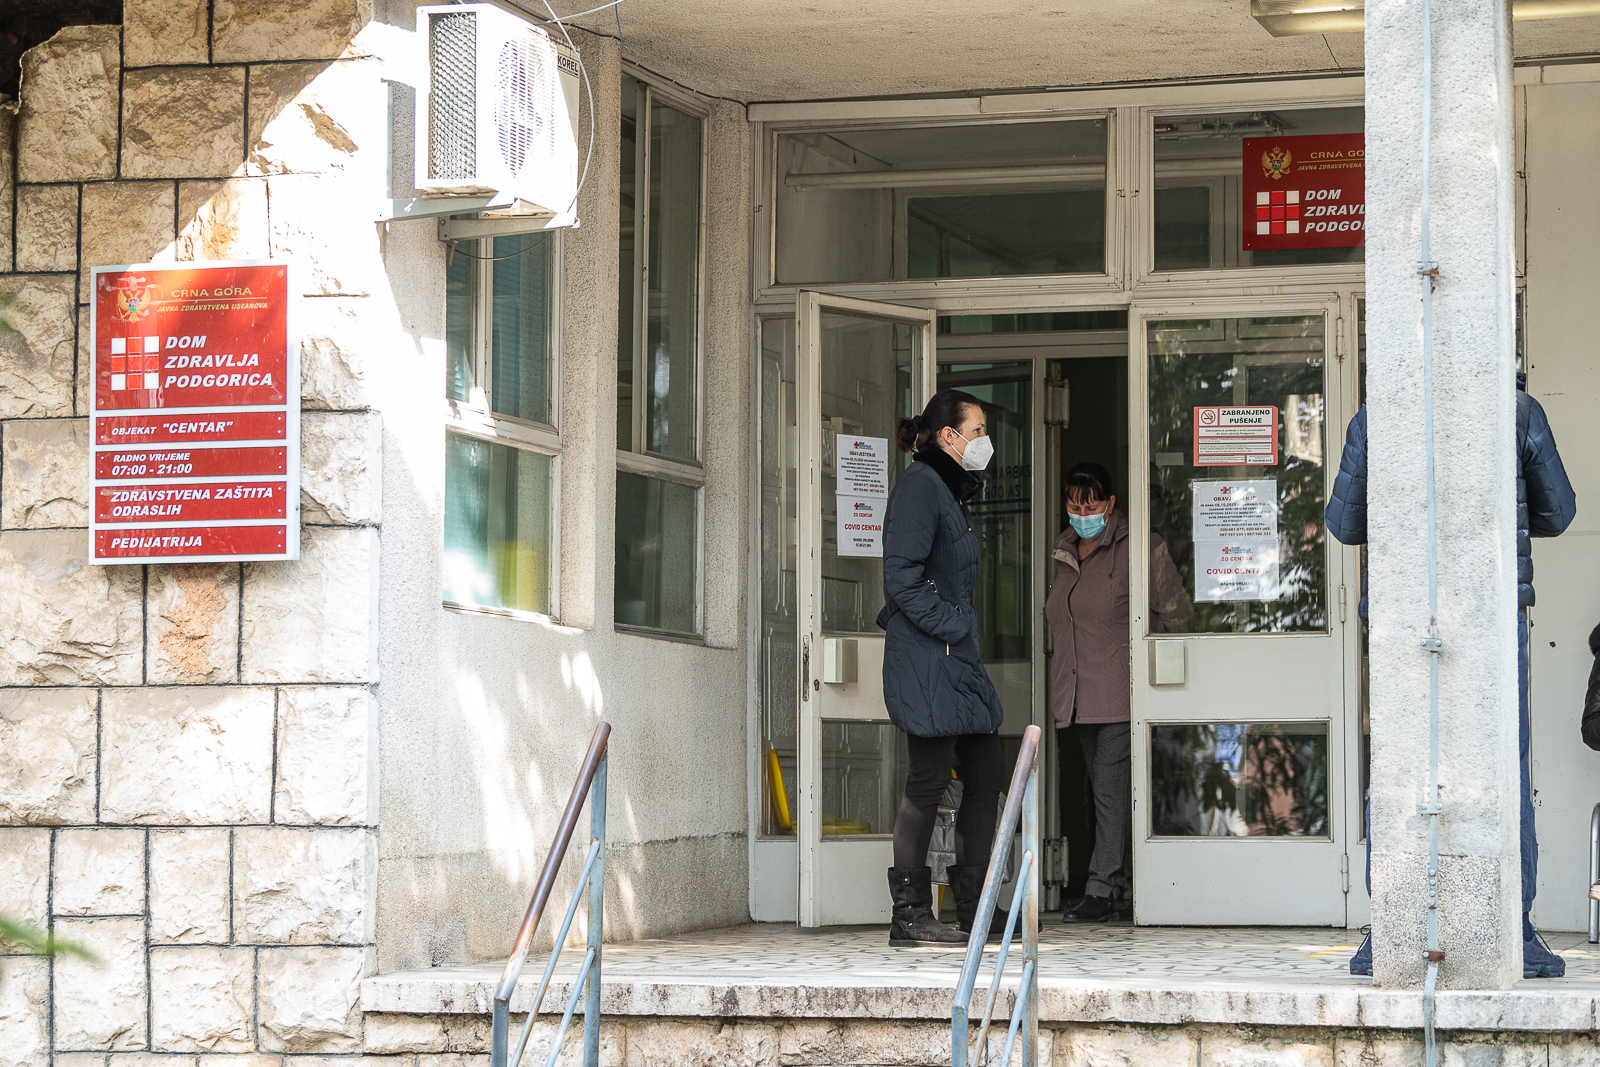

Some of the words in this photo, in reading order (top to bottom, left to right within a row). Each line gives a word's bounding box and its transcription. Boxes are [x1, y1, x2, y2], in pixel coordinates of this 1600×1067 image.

[558, 55, 578, 72] KOREL
[1310, 151, 1343, 159] CRNA
[1305, 189, 1342, 201] DOM
[1304, 204, 1365, 217] ZDRAVL
[1305, 220, 1365, 233] PODGO
[171, 288, 209, 298] CRNA
[214, 287, 252, 297] GORA
[180, 304, 229, 312] ZDRAVSTVENA
[165, 335, 207, 349] DOM
[164, 354, 259, 369] ZDRAVLJA
[164, 373, 272, 389] PODGORICA
[111, 427, 157, 436] OBJEKAT
[163, 421, 233, 434] "CENTAR"
[113, 454, 146, 462] RADNO
[149, 453, 190, 461] VRIJEME
[111, 464, 147, 476] 07:00
[156, 463, 193, 475] 21:00
[111, 489, 210, 502] ZDRAVSTVENA
[214, 486, 273, 499] ZAŠTITA
[112, 504, 182, 517] ODRASLIH
[111, 536, 202, 548] PEDIJATRIJA
